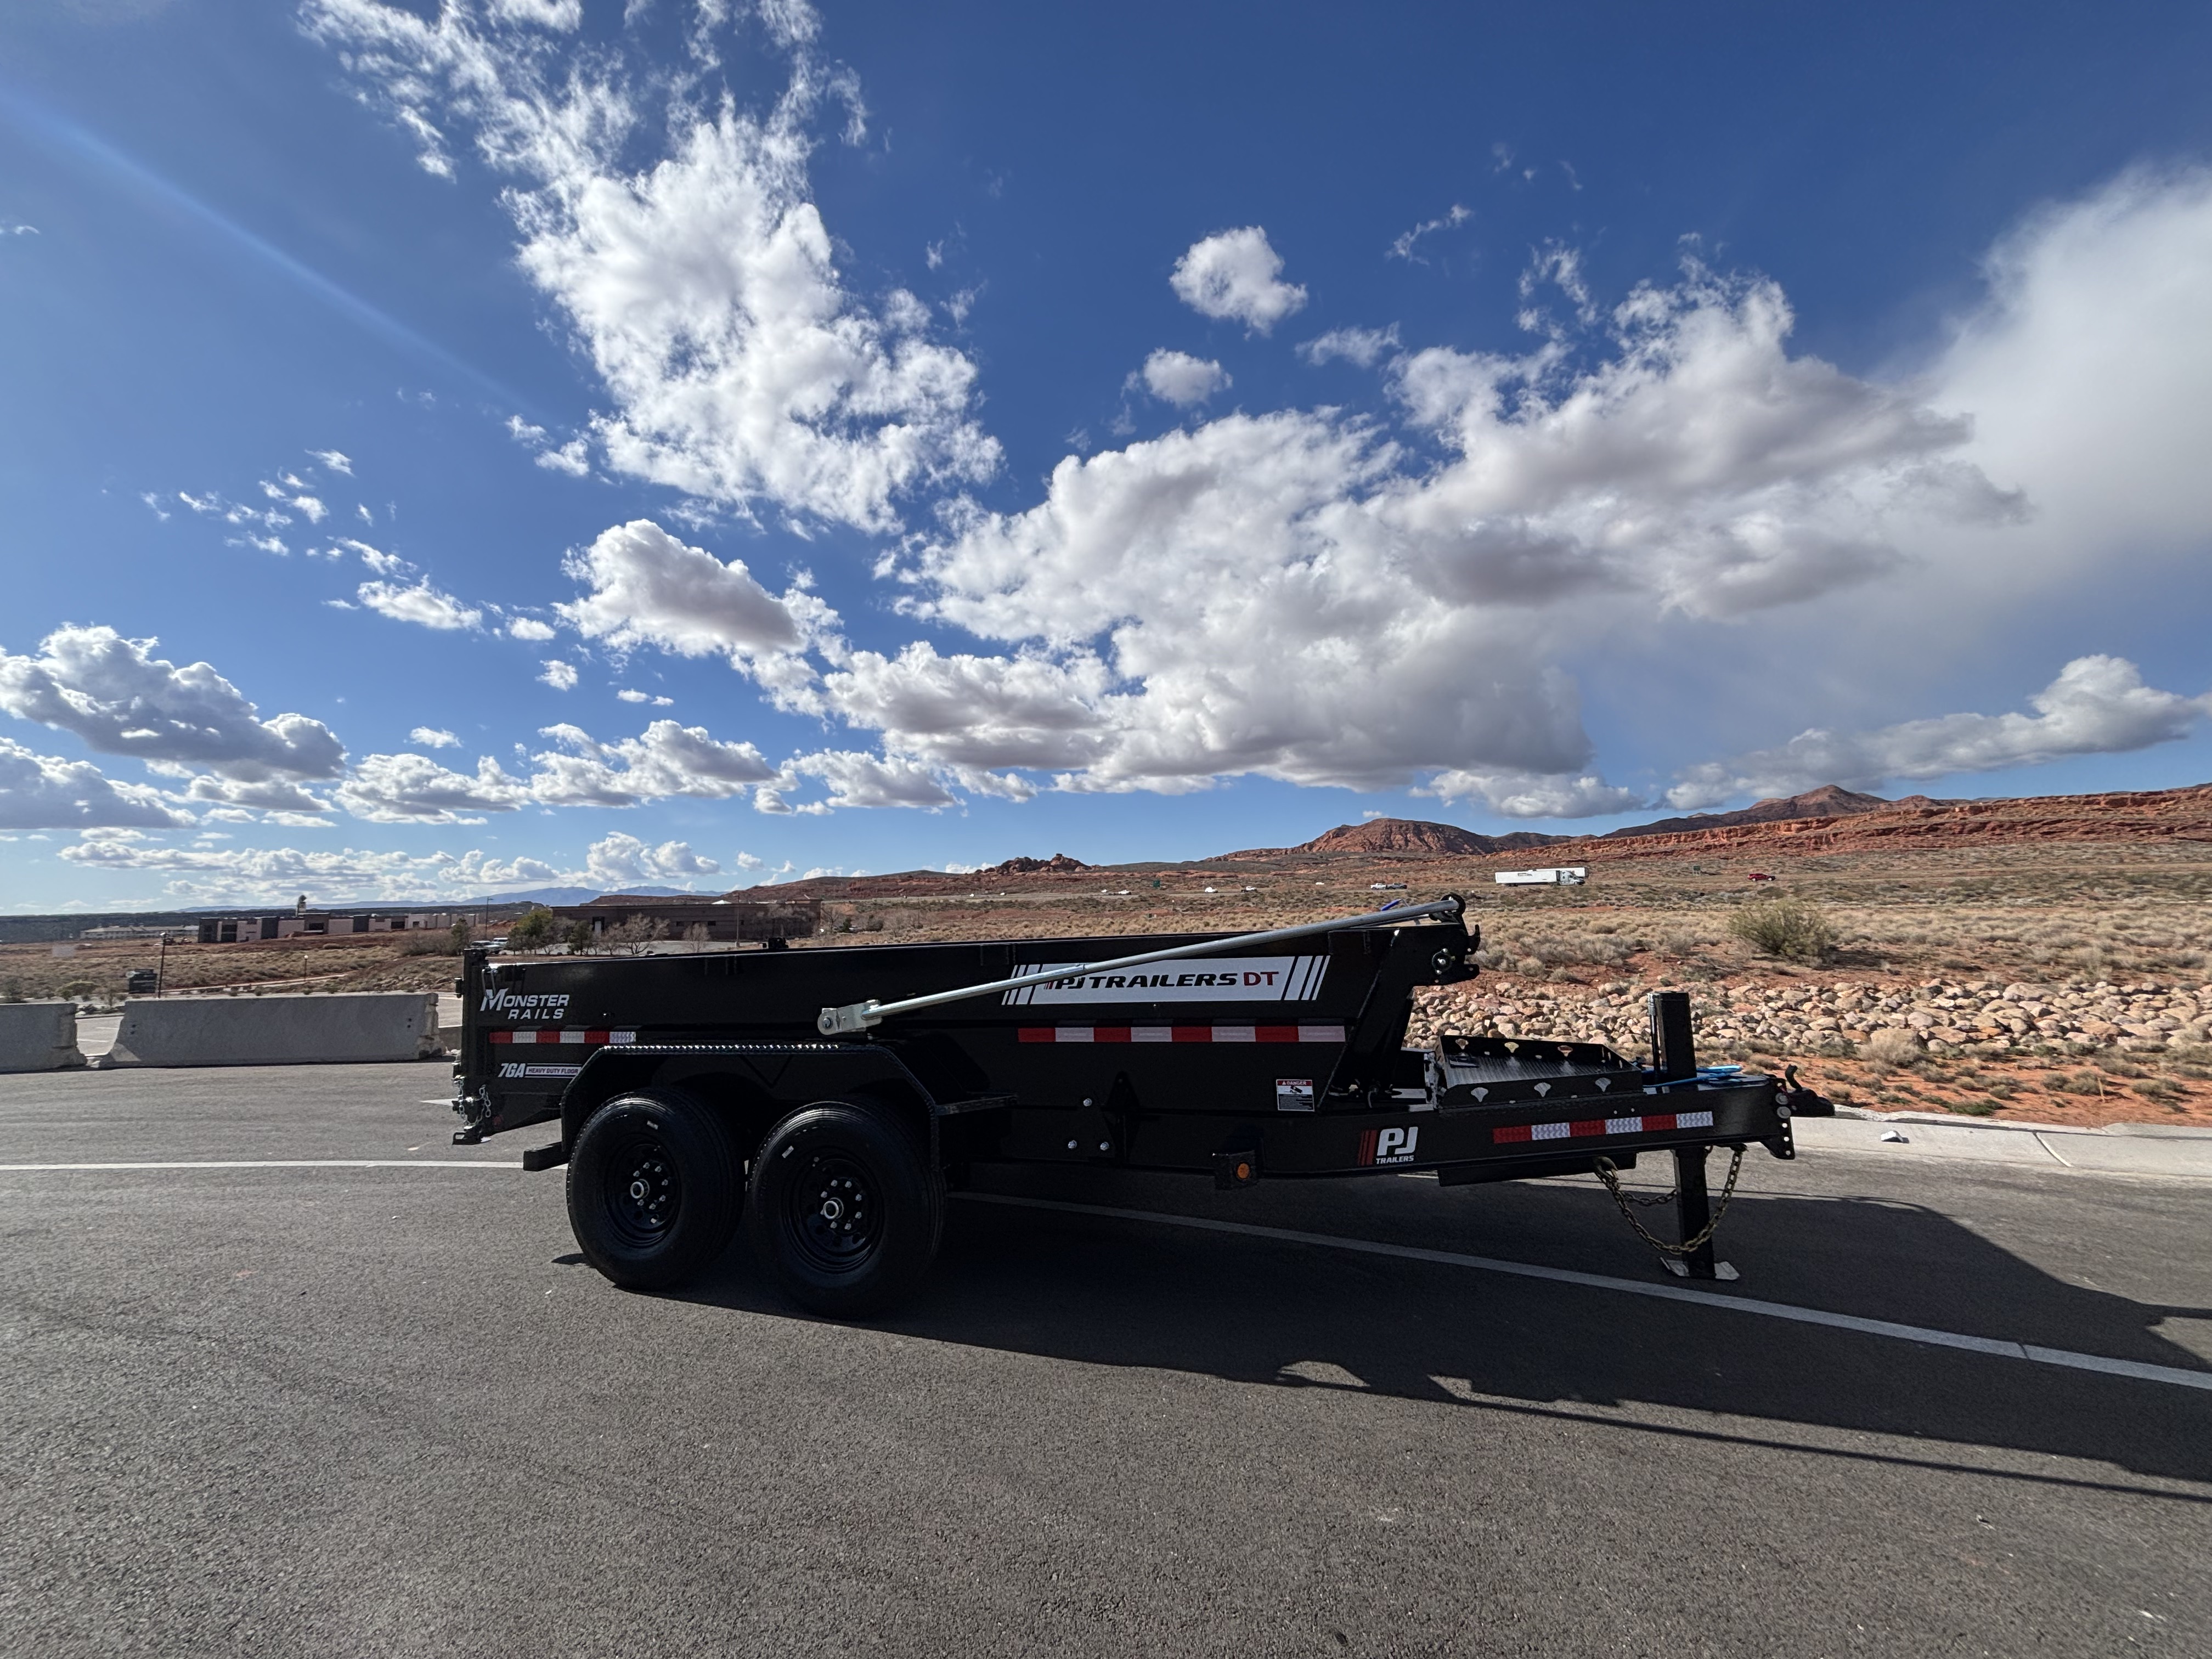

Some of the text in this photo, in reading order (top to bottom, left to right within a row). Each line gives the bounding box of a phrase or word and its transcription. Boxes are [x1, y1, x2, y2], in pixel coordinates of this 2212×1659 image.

[1054, 971, 1279, 989] PJ TRAILERS DT
[479, 988, 569, 1012] MONSTER
[507, 1008, 564, 1019] RAILS
[498, 1063, 526, 1078] 7GA
[1376, 1126, 1418, 1156] PJ
[1376, 1155, 1414, 1164] TRAILERS
